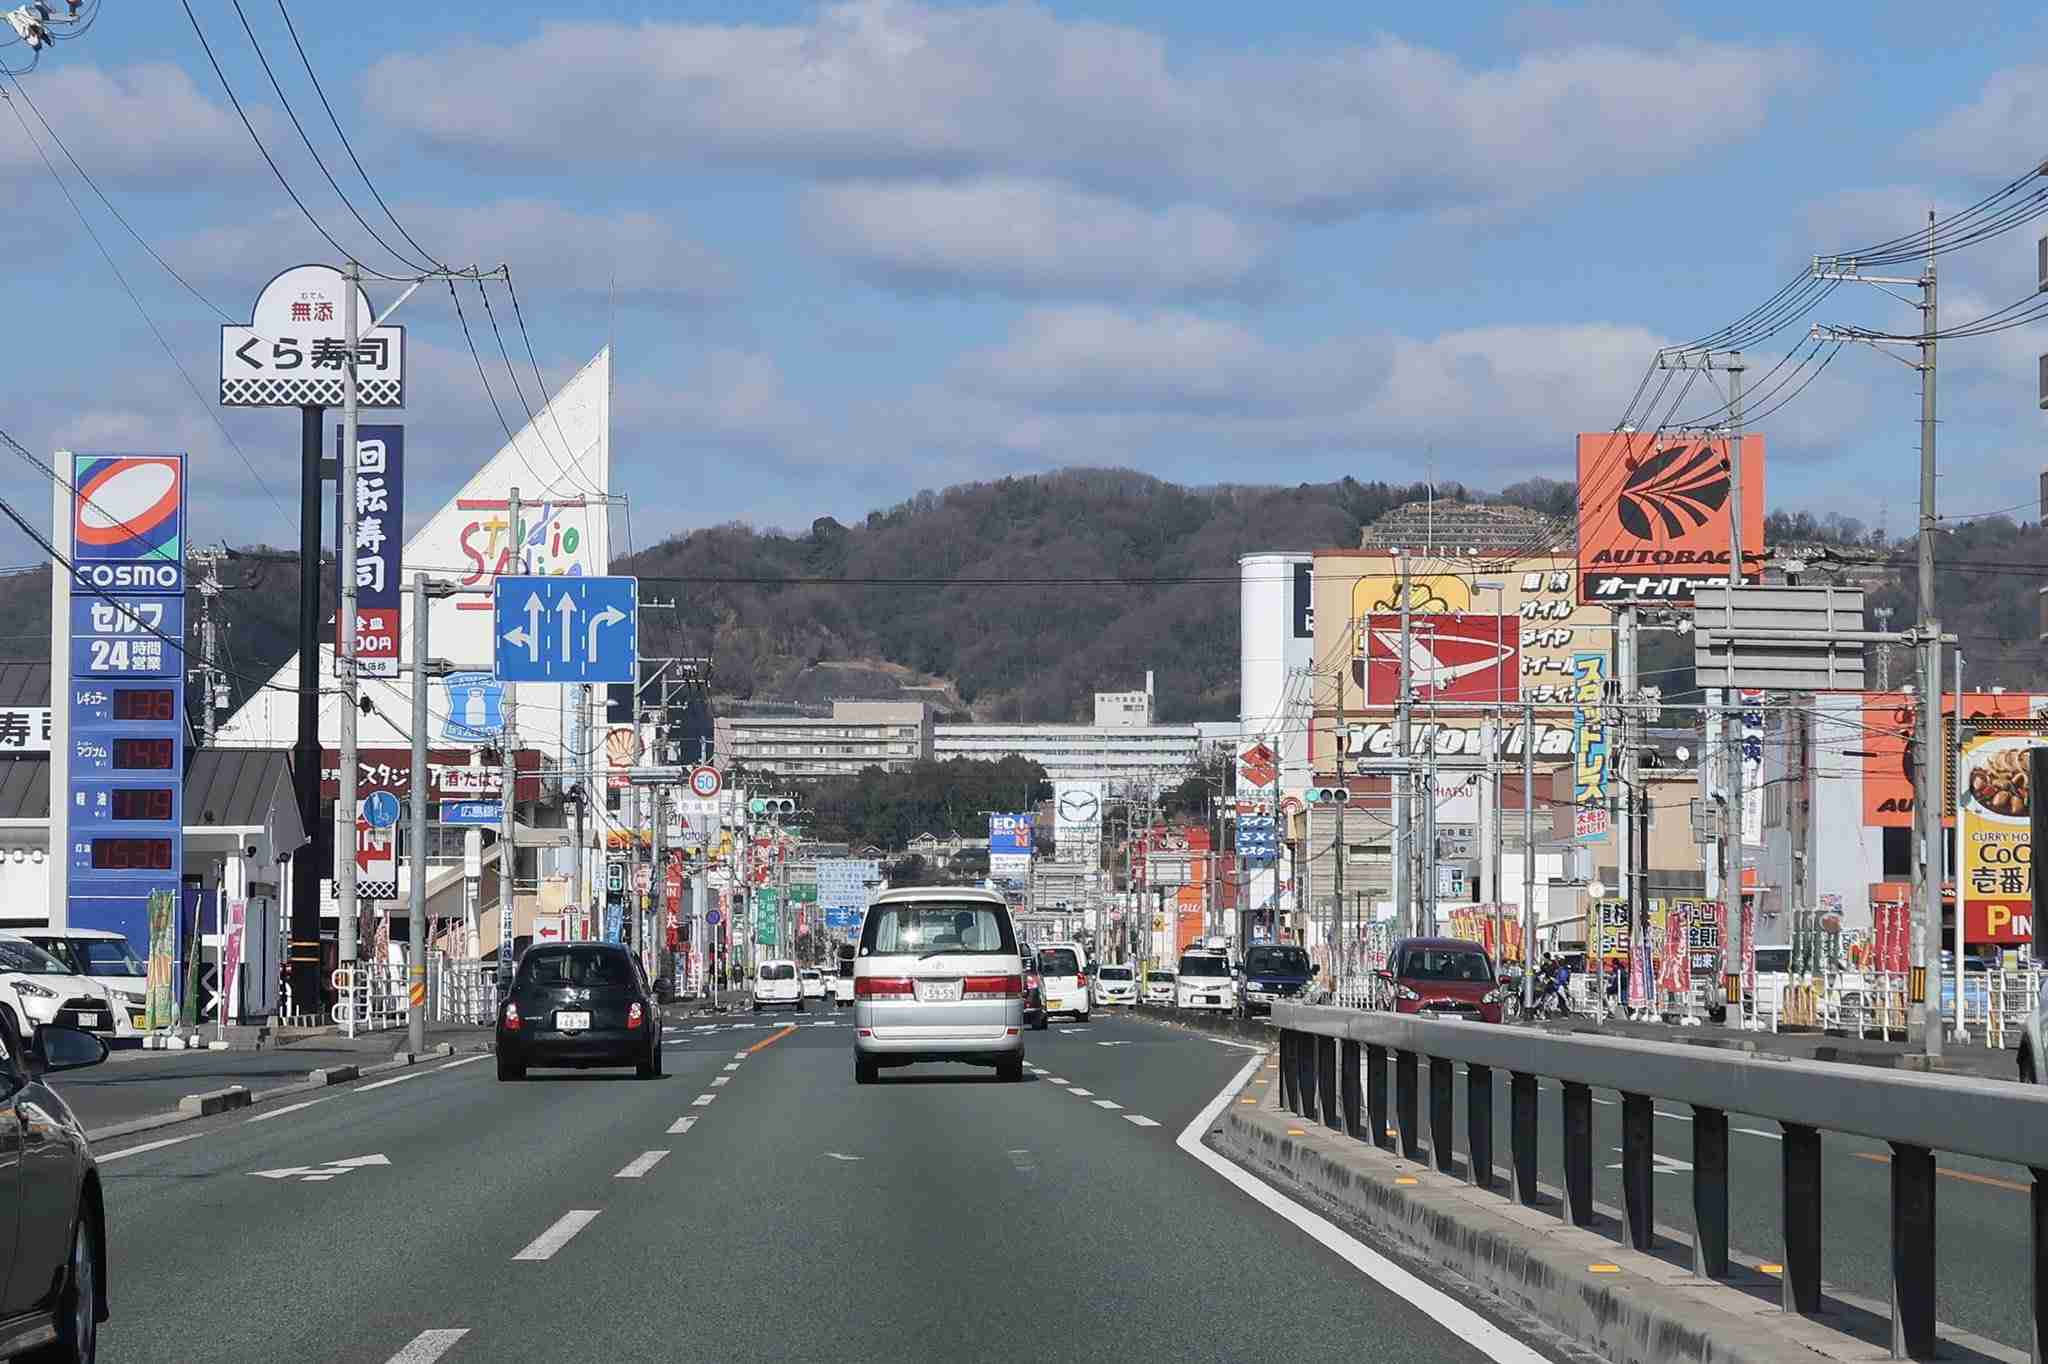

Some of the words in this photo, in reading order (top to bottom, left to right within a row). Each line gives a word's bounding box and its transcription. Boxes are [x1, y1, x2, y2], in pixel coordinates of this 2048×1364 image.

[291, 302, 333, 321] 無添
[235, 337, 388, 370] くら寿司
[356, 439, 388, 593] 回転寿司
[91, 602, 164, 633] セルフ
[1521, 599, 1573, 619] オイル
[1521, 628, 1572, 648] タイヤ
[90, 639, 131, 671] 24
[697, 775, 714, 789] 50
[1972, 832, 2010, 841] CURRY
[1972, 866, 2032, 894] 壱番
